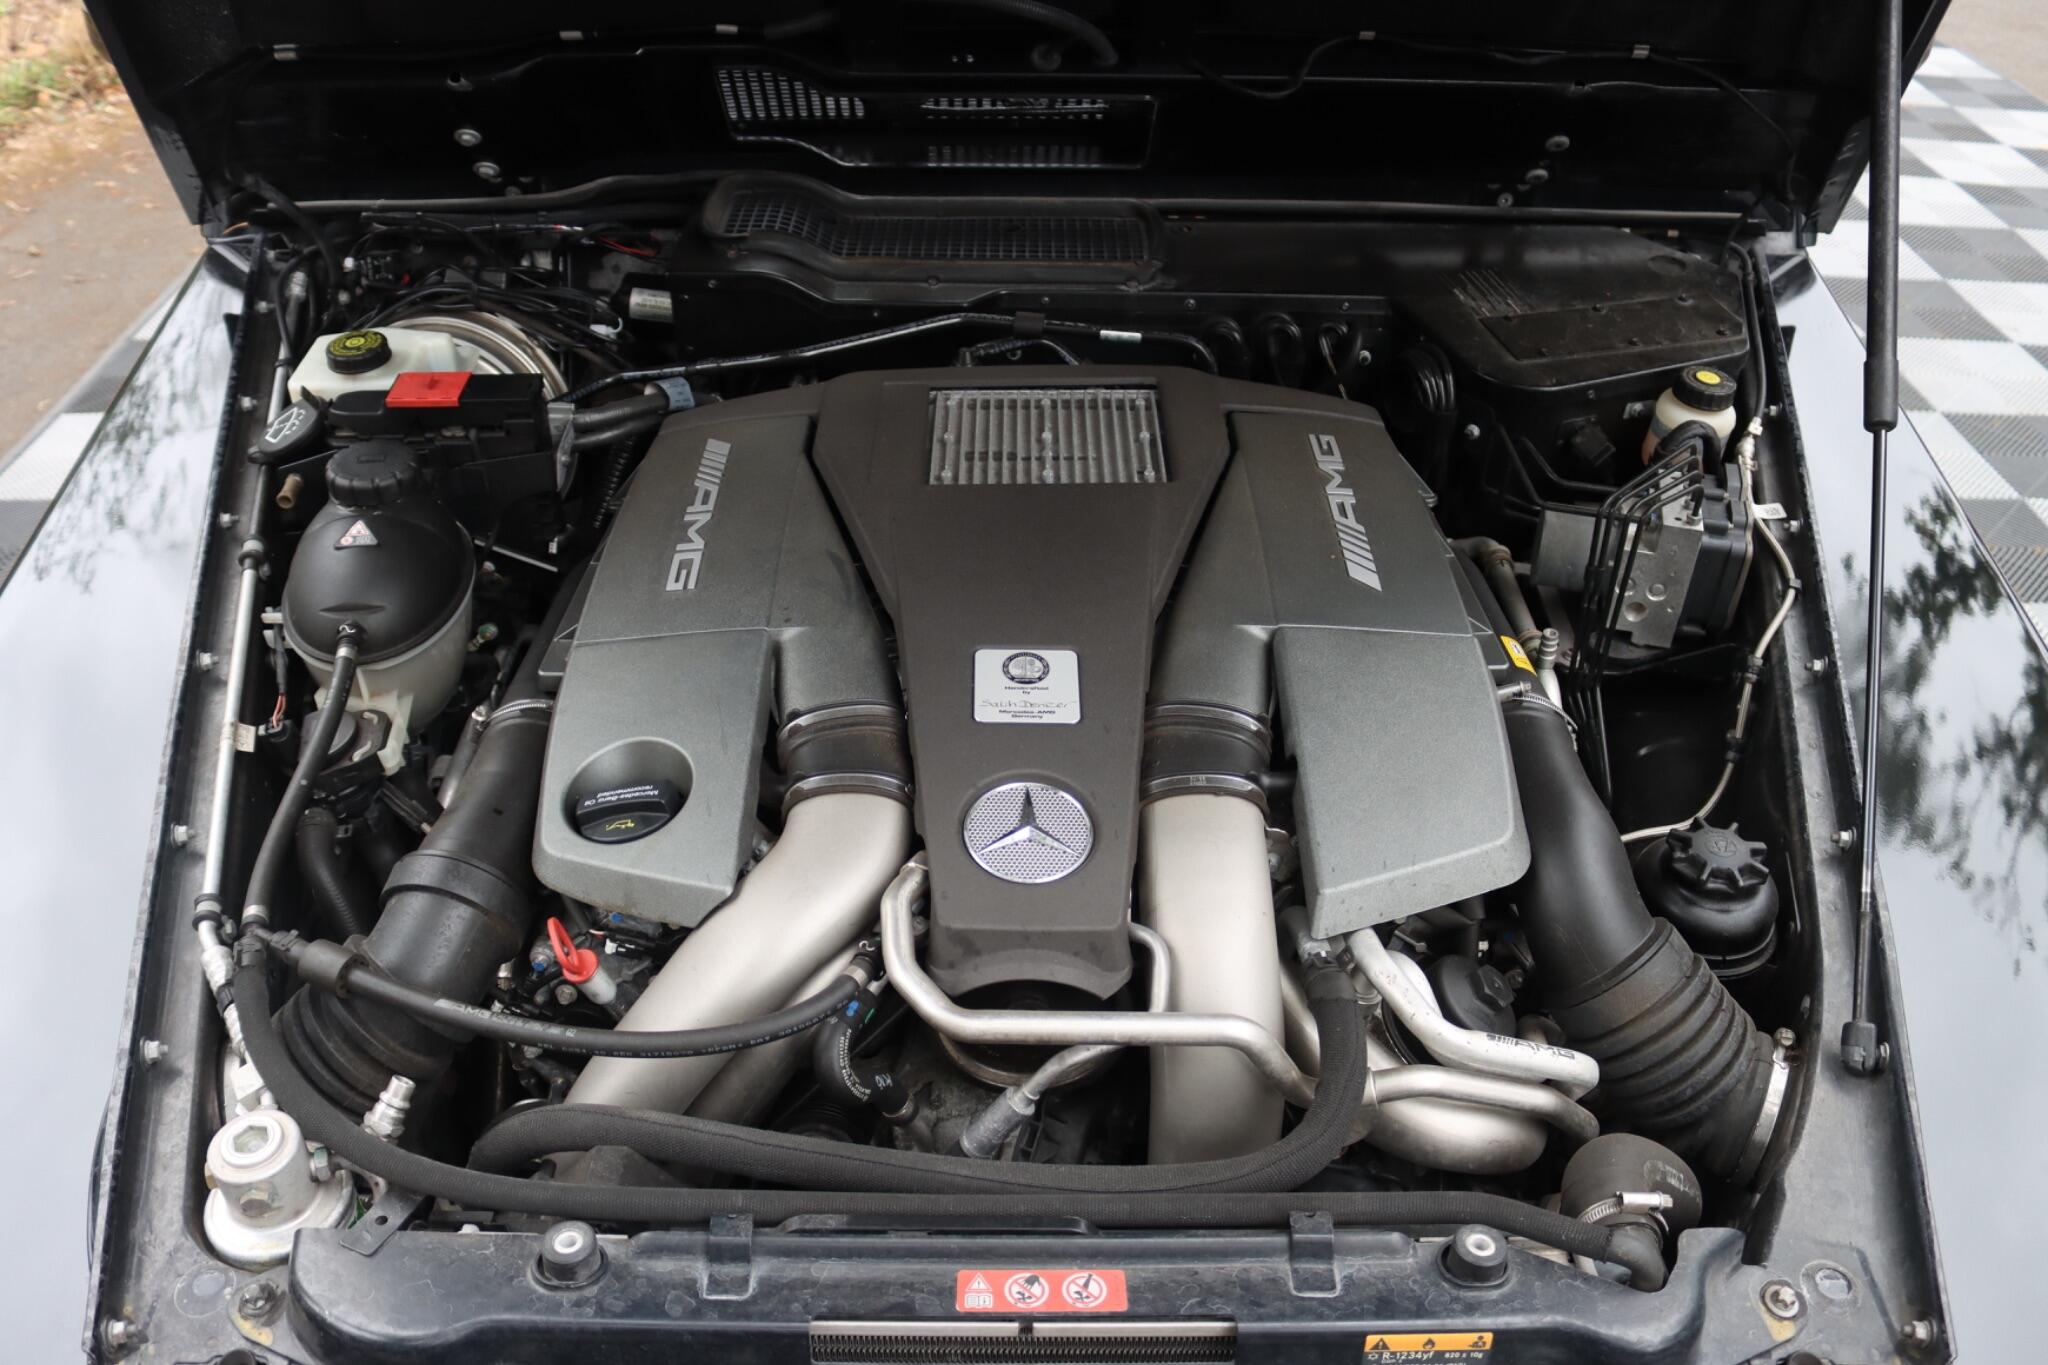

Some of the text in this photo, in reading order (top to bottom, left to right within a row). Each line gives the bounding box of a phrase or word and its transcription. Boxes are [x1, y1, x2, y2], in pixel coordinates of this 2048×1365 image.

[666, 474, 720, 592] AMG
[1308, 433, 1367, 546] AMG
[1382, 1351, 1434, 1361] R-1234yf
